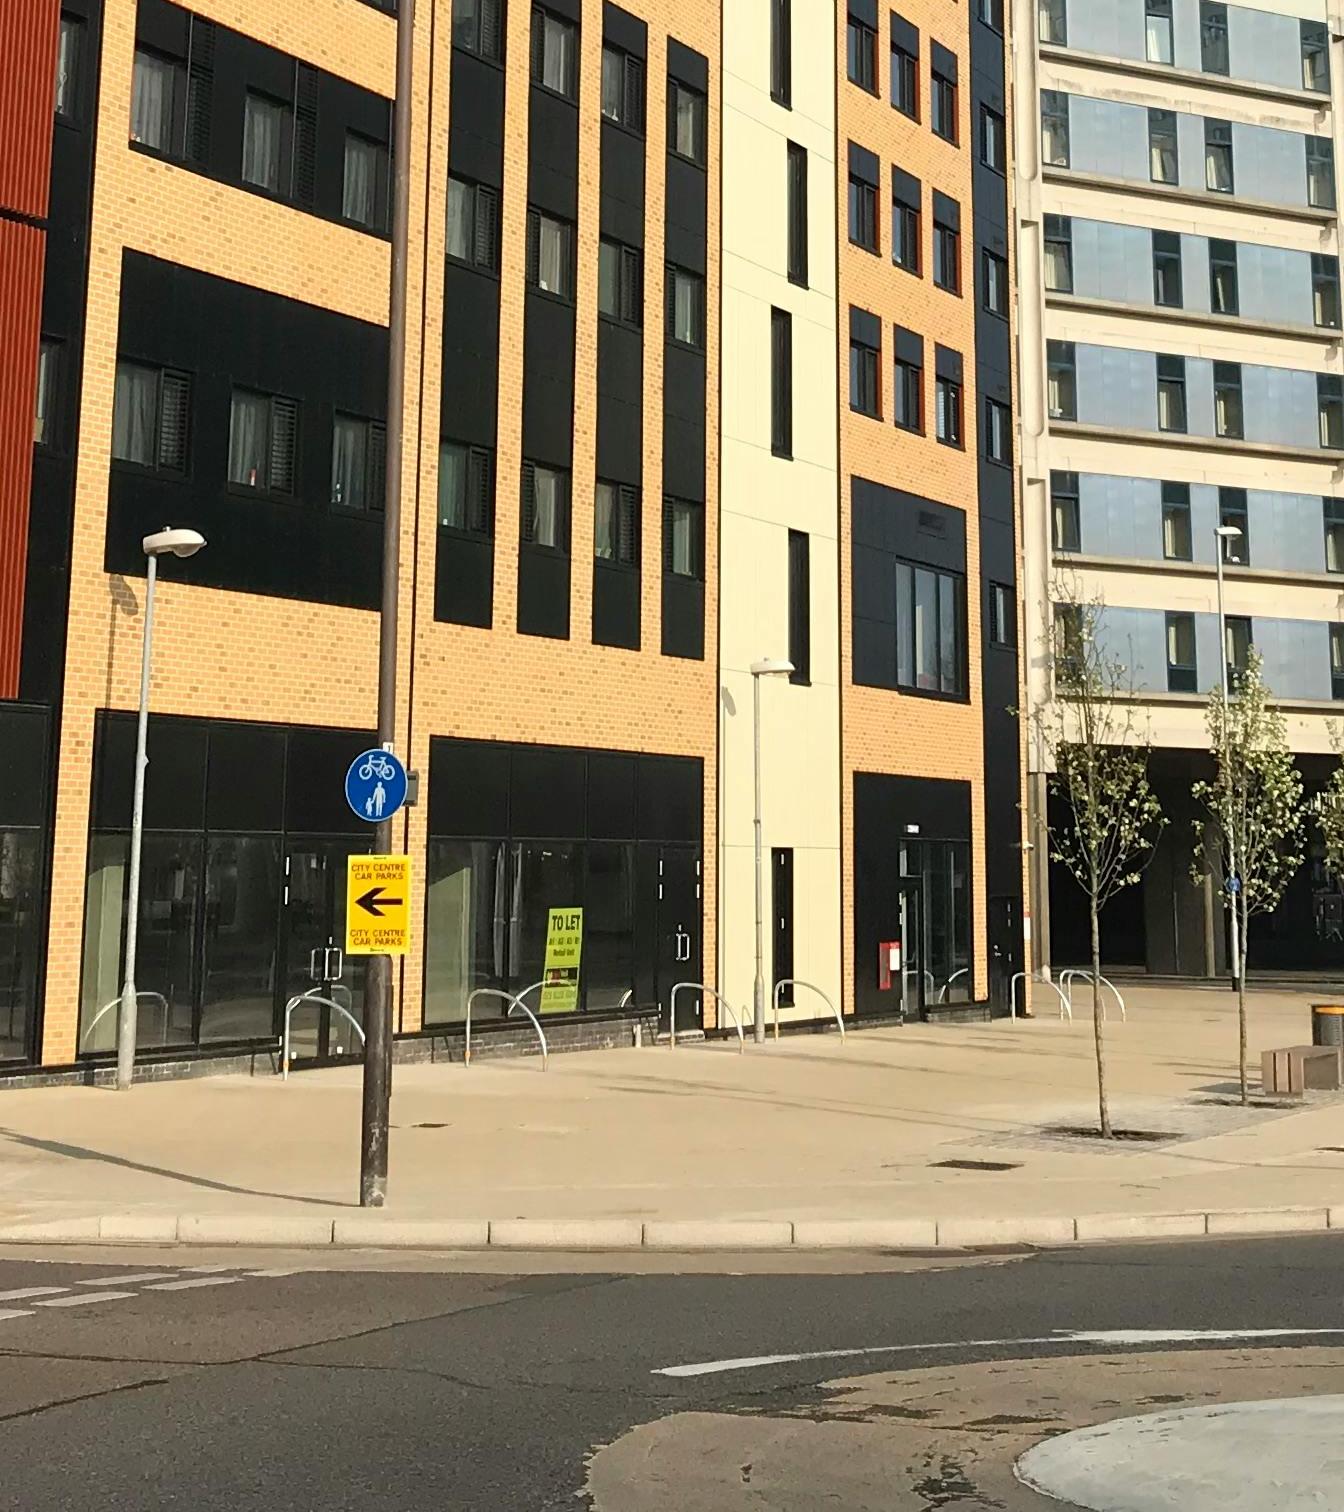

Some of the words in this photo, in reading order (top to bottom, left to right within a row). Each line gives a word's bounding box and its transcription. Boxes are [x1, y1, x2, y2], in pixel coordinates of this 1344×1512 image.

[351, 863, 370, 872] CITY
[373, 863, 406, 872] CENTRE
[355, 872, 372, 880] CAR
[376, 872, 404, 880] PARKS
[552, 915, 563, 931] TO
[565, 915, 581, 931] LET
[350, 929, 369, 938] CITY
[372, 929, 405, 938] CENTRE
[353, 937, 370, 946] CAR
[375, 937, 402, 946] PARKS
